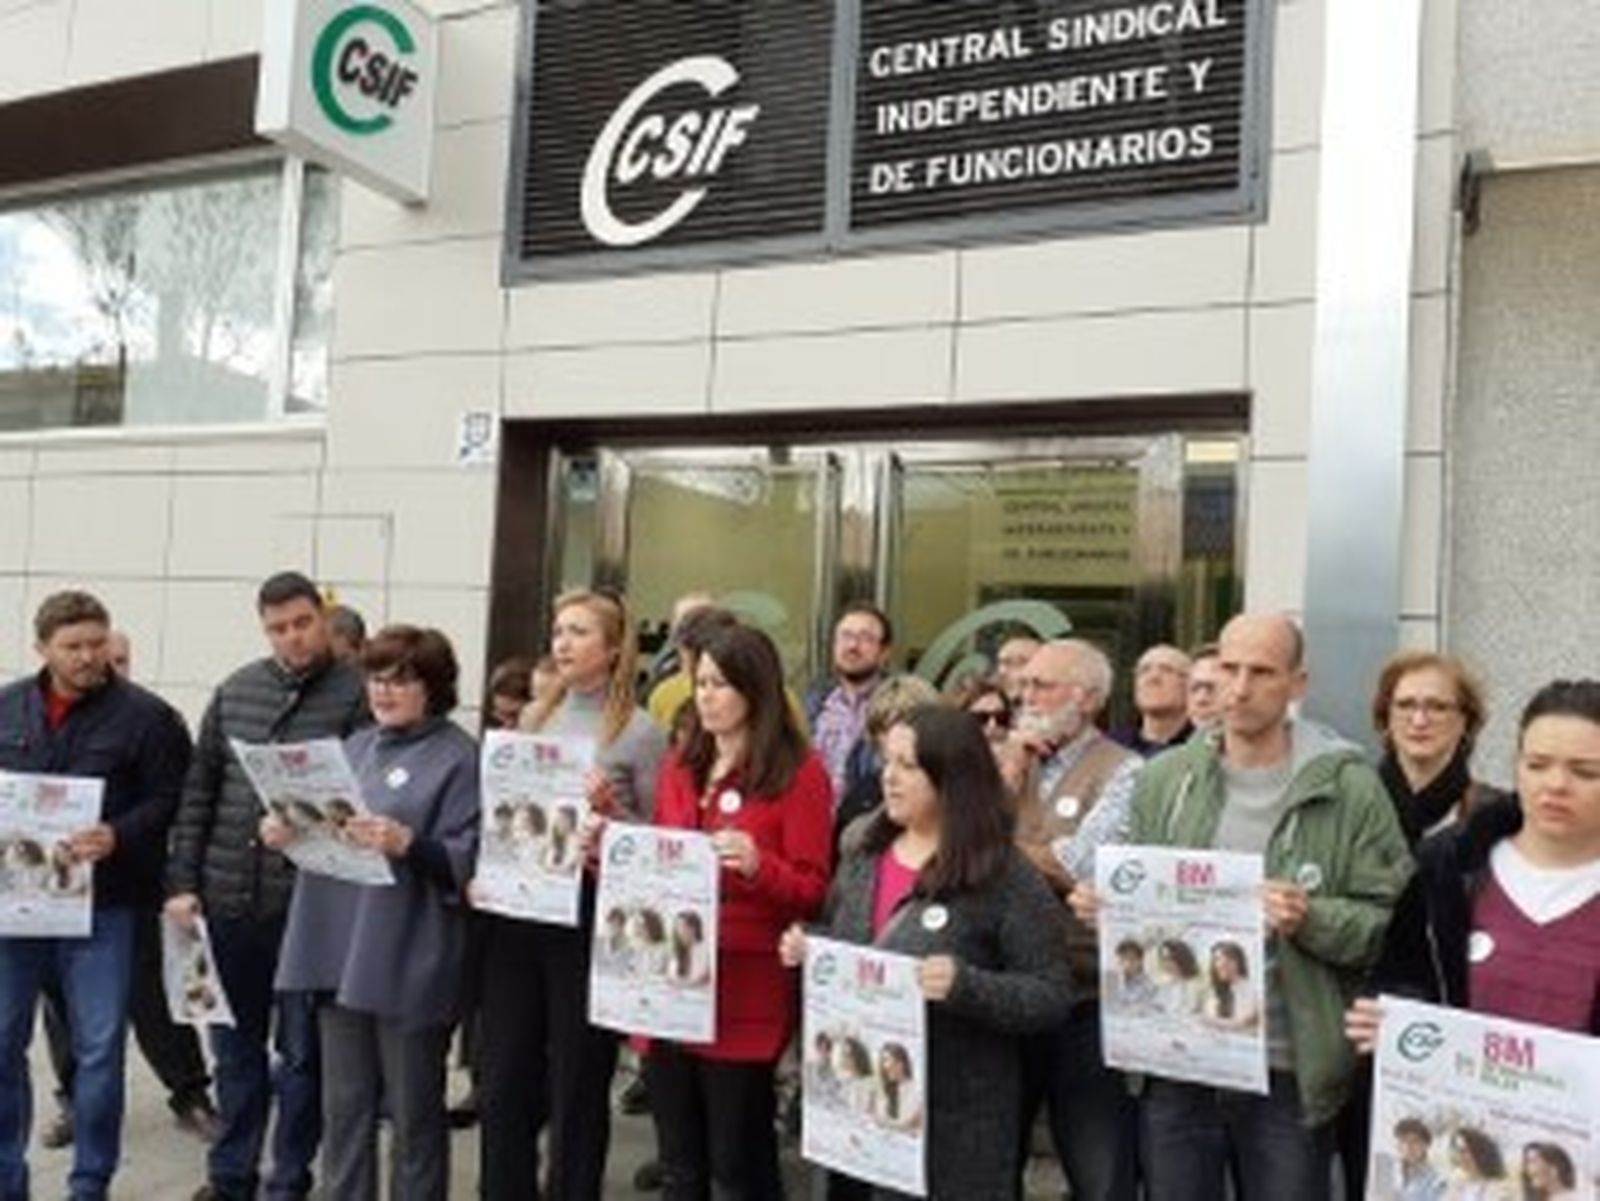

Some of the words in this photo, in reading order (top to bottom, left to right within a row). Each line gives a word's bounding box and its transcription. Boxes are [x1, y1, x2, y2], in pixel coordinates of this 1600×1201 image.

[338, 38, 418, 108] CSIF
[869, 27, 1031, 77] CENTRAL
[1048, 0, 1227, 50] SINDICAL
[876, 66, 1169, 134] INDEPENDIENTE
[1188, 58, 1213, 93] Y
[615, 104, 760, 183] CSIF
[868, 163, 915, 193] DE
[925, 124, 1214, 187] FUNCIONARIOS
